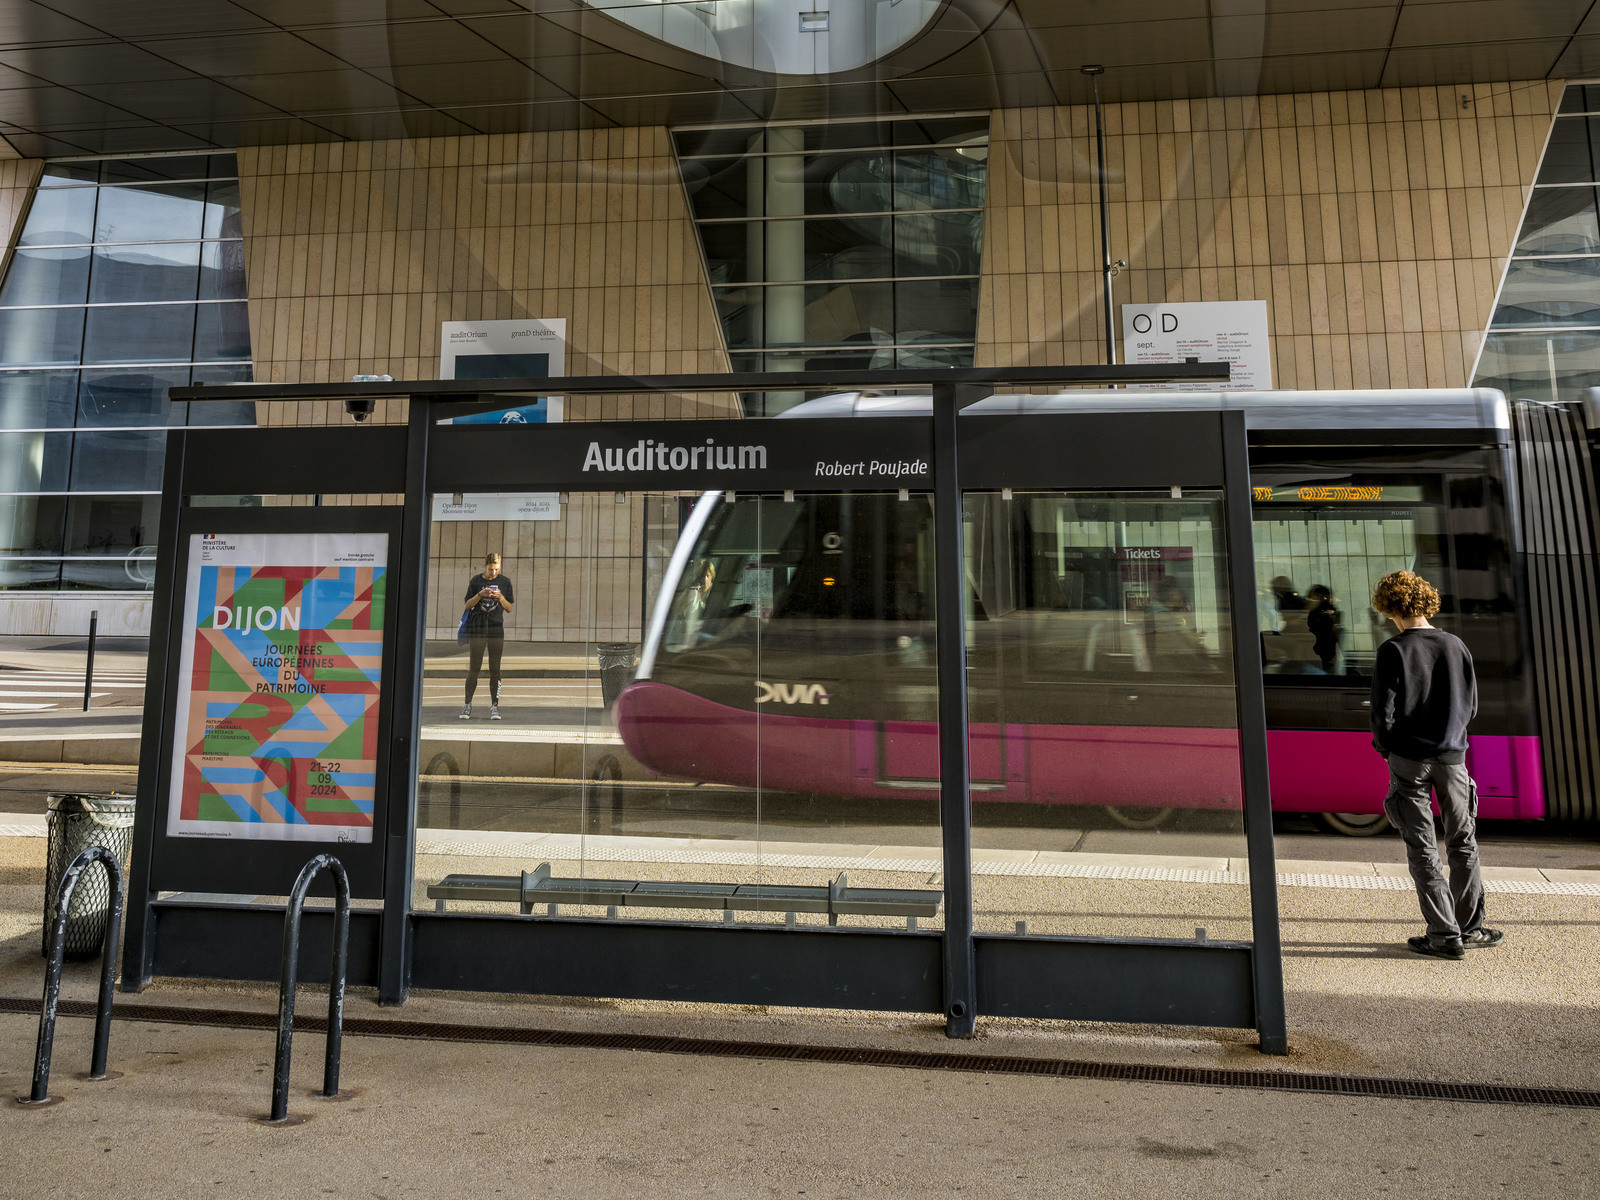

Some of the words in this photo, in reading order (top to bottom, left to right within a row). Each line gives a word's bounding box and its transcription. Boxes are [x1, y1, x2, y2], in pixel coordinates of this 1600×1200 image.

[1133, 314, 1152, 333] O
[1162, 313, 1178, 332] D
[450, 331, 488, 339] auditOrium
[532, 328, 556, 337] théâtre
[1136, 341, 1156, 349] sept.
[582, 438, 767, 472] Auditorium
[815, 460, 865, 476] Robert
[869, 459, 928, 478] Poujade
[1123, 548, 1161, 559] Tickets
[212, 606, 300, 636] DIJON
[264, 643, 323, 656] JOURNÉES
[252, 655, 334, 669] EUROPÉENNES
[284, 671, 300, 681] DU
[256, 683, 326, 694] PATRIMOINE
[317, 773, 332, 784] 09
[310, 784, 337, 795] 2024
